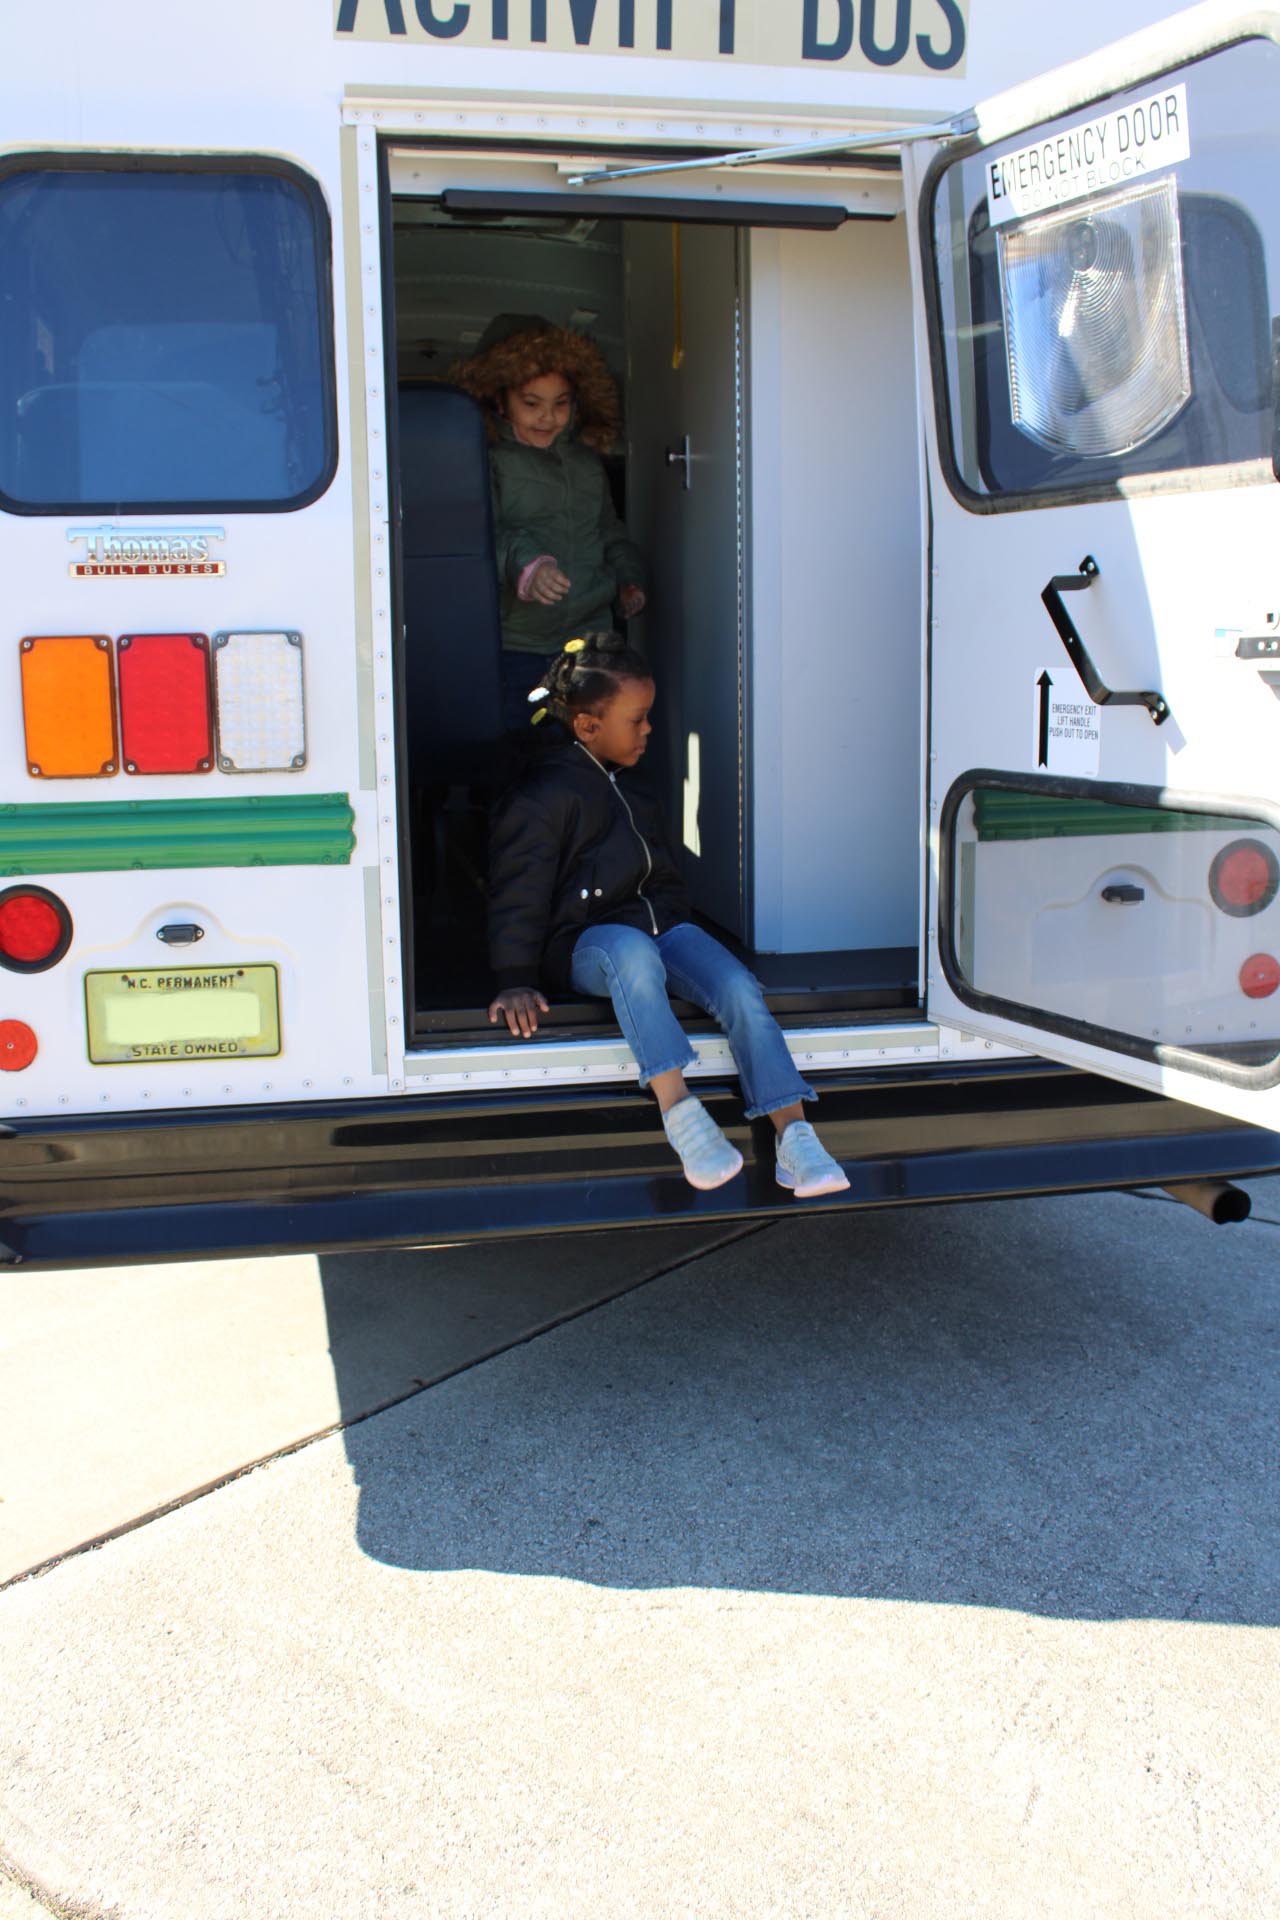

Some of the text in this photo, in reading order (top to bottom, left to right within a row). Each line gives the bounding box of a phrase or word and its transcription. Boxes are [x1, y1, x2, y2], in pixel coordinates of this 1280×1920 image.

[990, 94, 1179, 200] EMERGENCY DOOR
[1021, 151, 1147, 211] DO NOT BLOCK
[66, 524, 225, 563] Thomas
[83, 563, 214, 575] BUILT BUSES
[1052, 704, 1096, 716] EMERGENCY EXIT
[1057, 716, 1090, 728] LIFT HANDLE
[1049, 727, 1099, 740] PUSH OUT TO OPEN
[157, 974, 236, 989] PERMANENT
[131, 1042, 239, 1057] STATE OWNED
